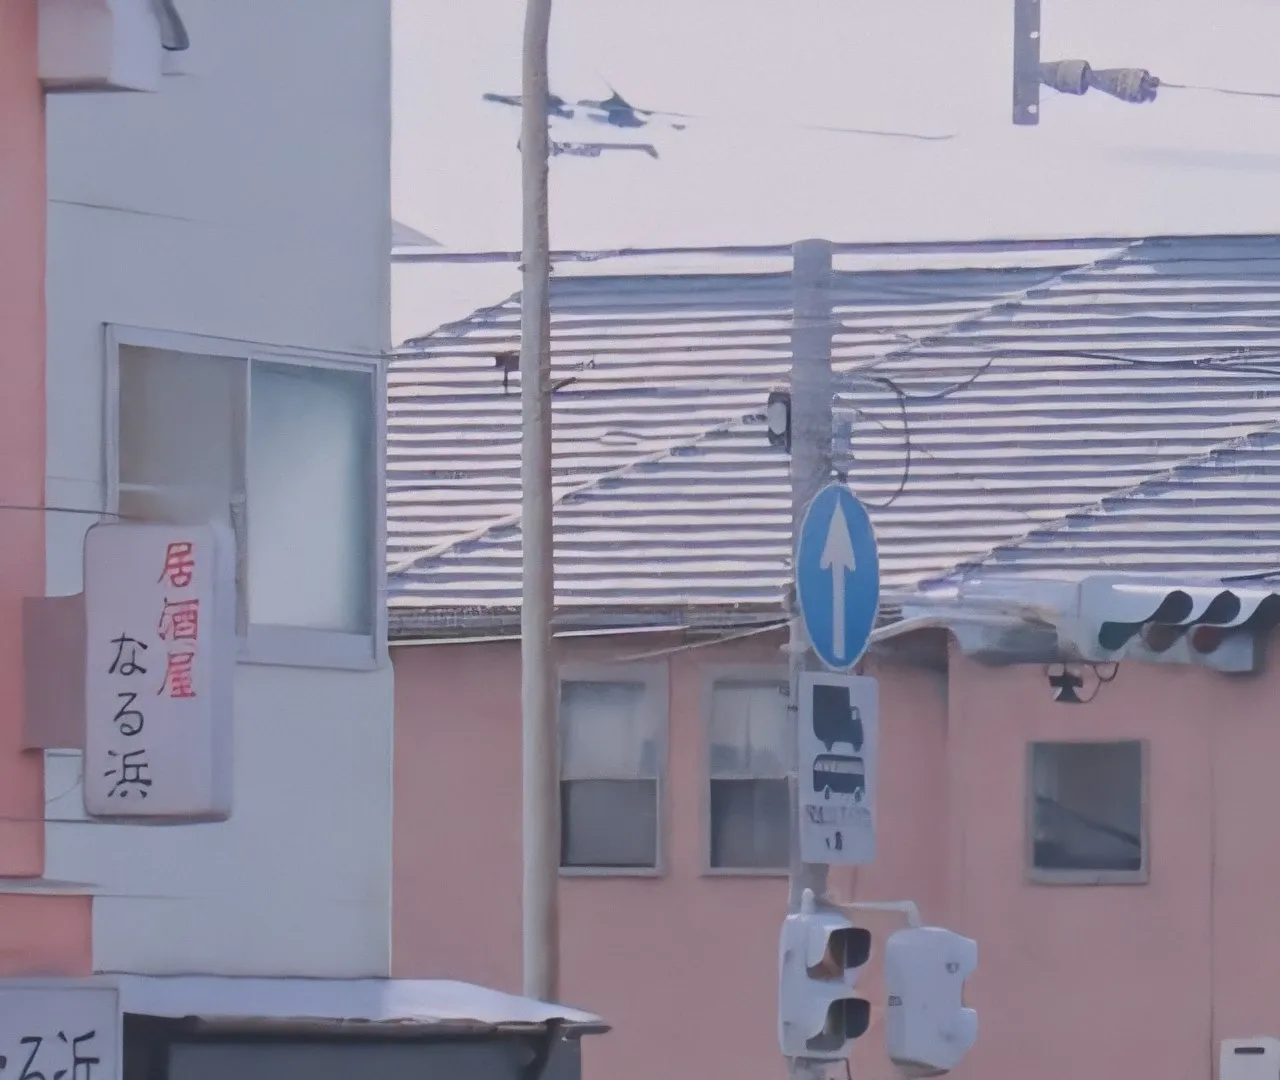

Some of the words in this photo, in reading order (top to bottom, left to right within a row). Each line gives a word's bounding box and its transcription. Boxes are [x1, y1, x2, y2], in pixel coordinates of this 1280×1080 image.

[157, 541, 200, 698] 居酒屋
[104, 631, 152, 799] なる浜
